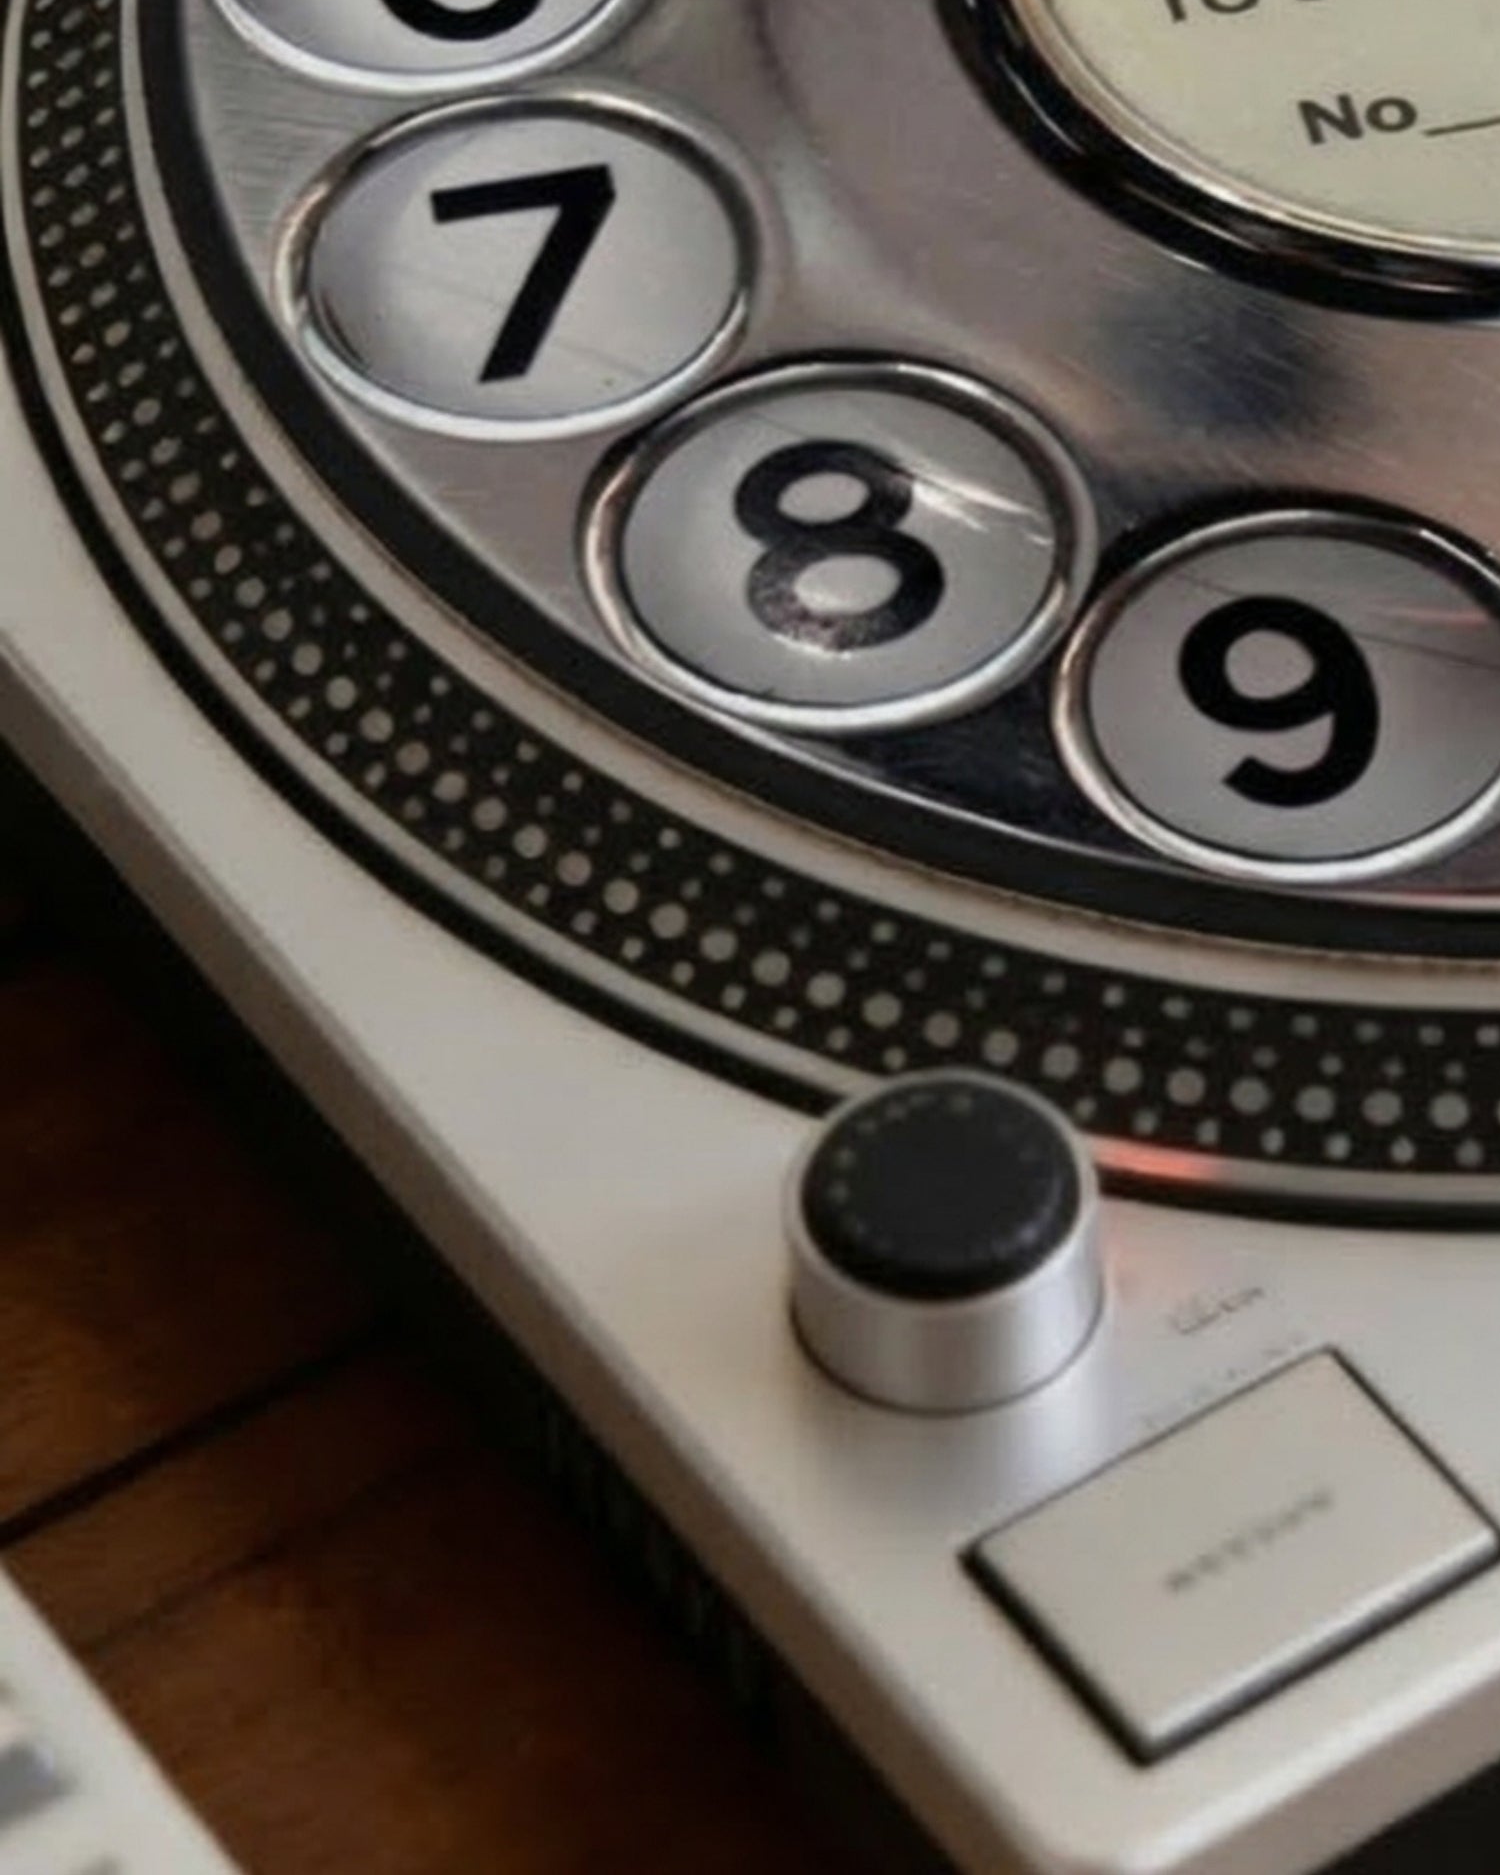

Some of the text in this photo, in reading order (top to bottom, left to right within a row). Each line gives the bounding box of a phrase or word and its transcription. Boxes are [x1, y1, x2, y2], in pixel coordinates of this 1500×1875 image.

[430, 164, 616, 383] 7
[734, 439, 946, 650] 8
[1177, 593, 1381, 809] 9
